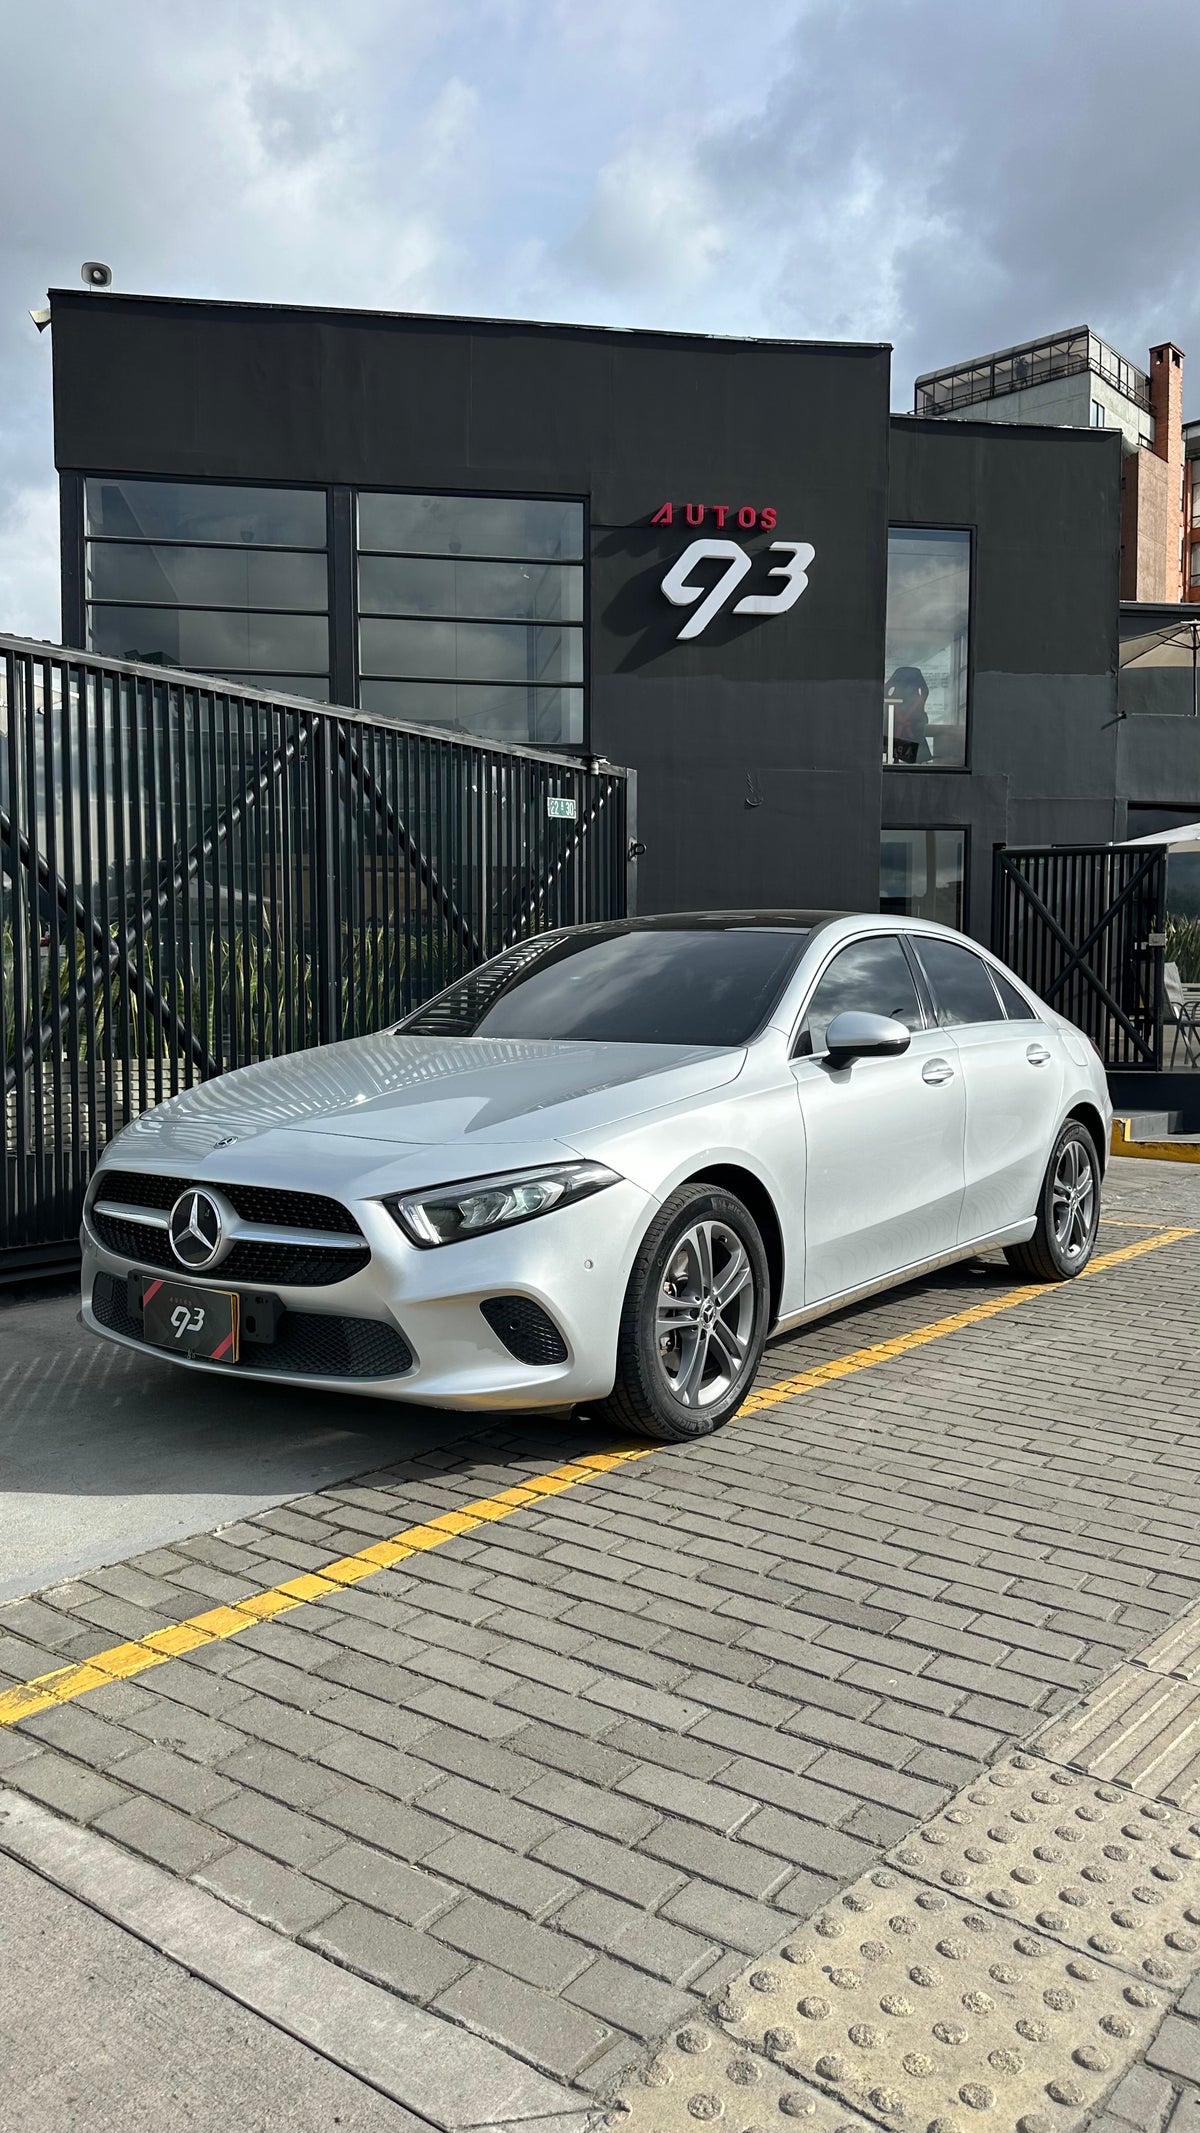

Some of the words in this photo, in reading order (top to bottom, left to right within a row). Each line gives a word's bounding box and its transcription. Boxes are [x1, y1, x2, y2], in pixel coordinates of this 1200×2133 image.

[650, 502, 777, 532] AUTOS
[661, 538, 816, 641] 93
[170, 1305, 206, 1339] 93
